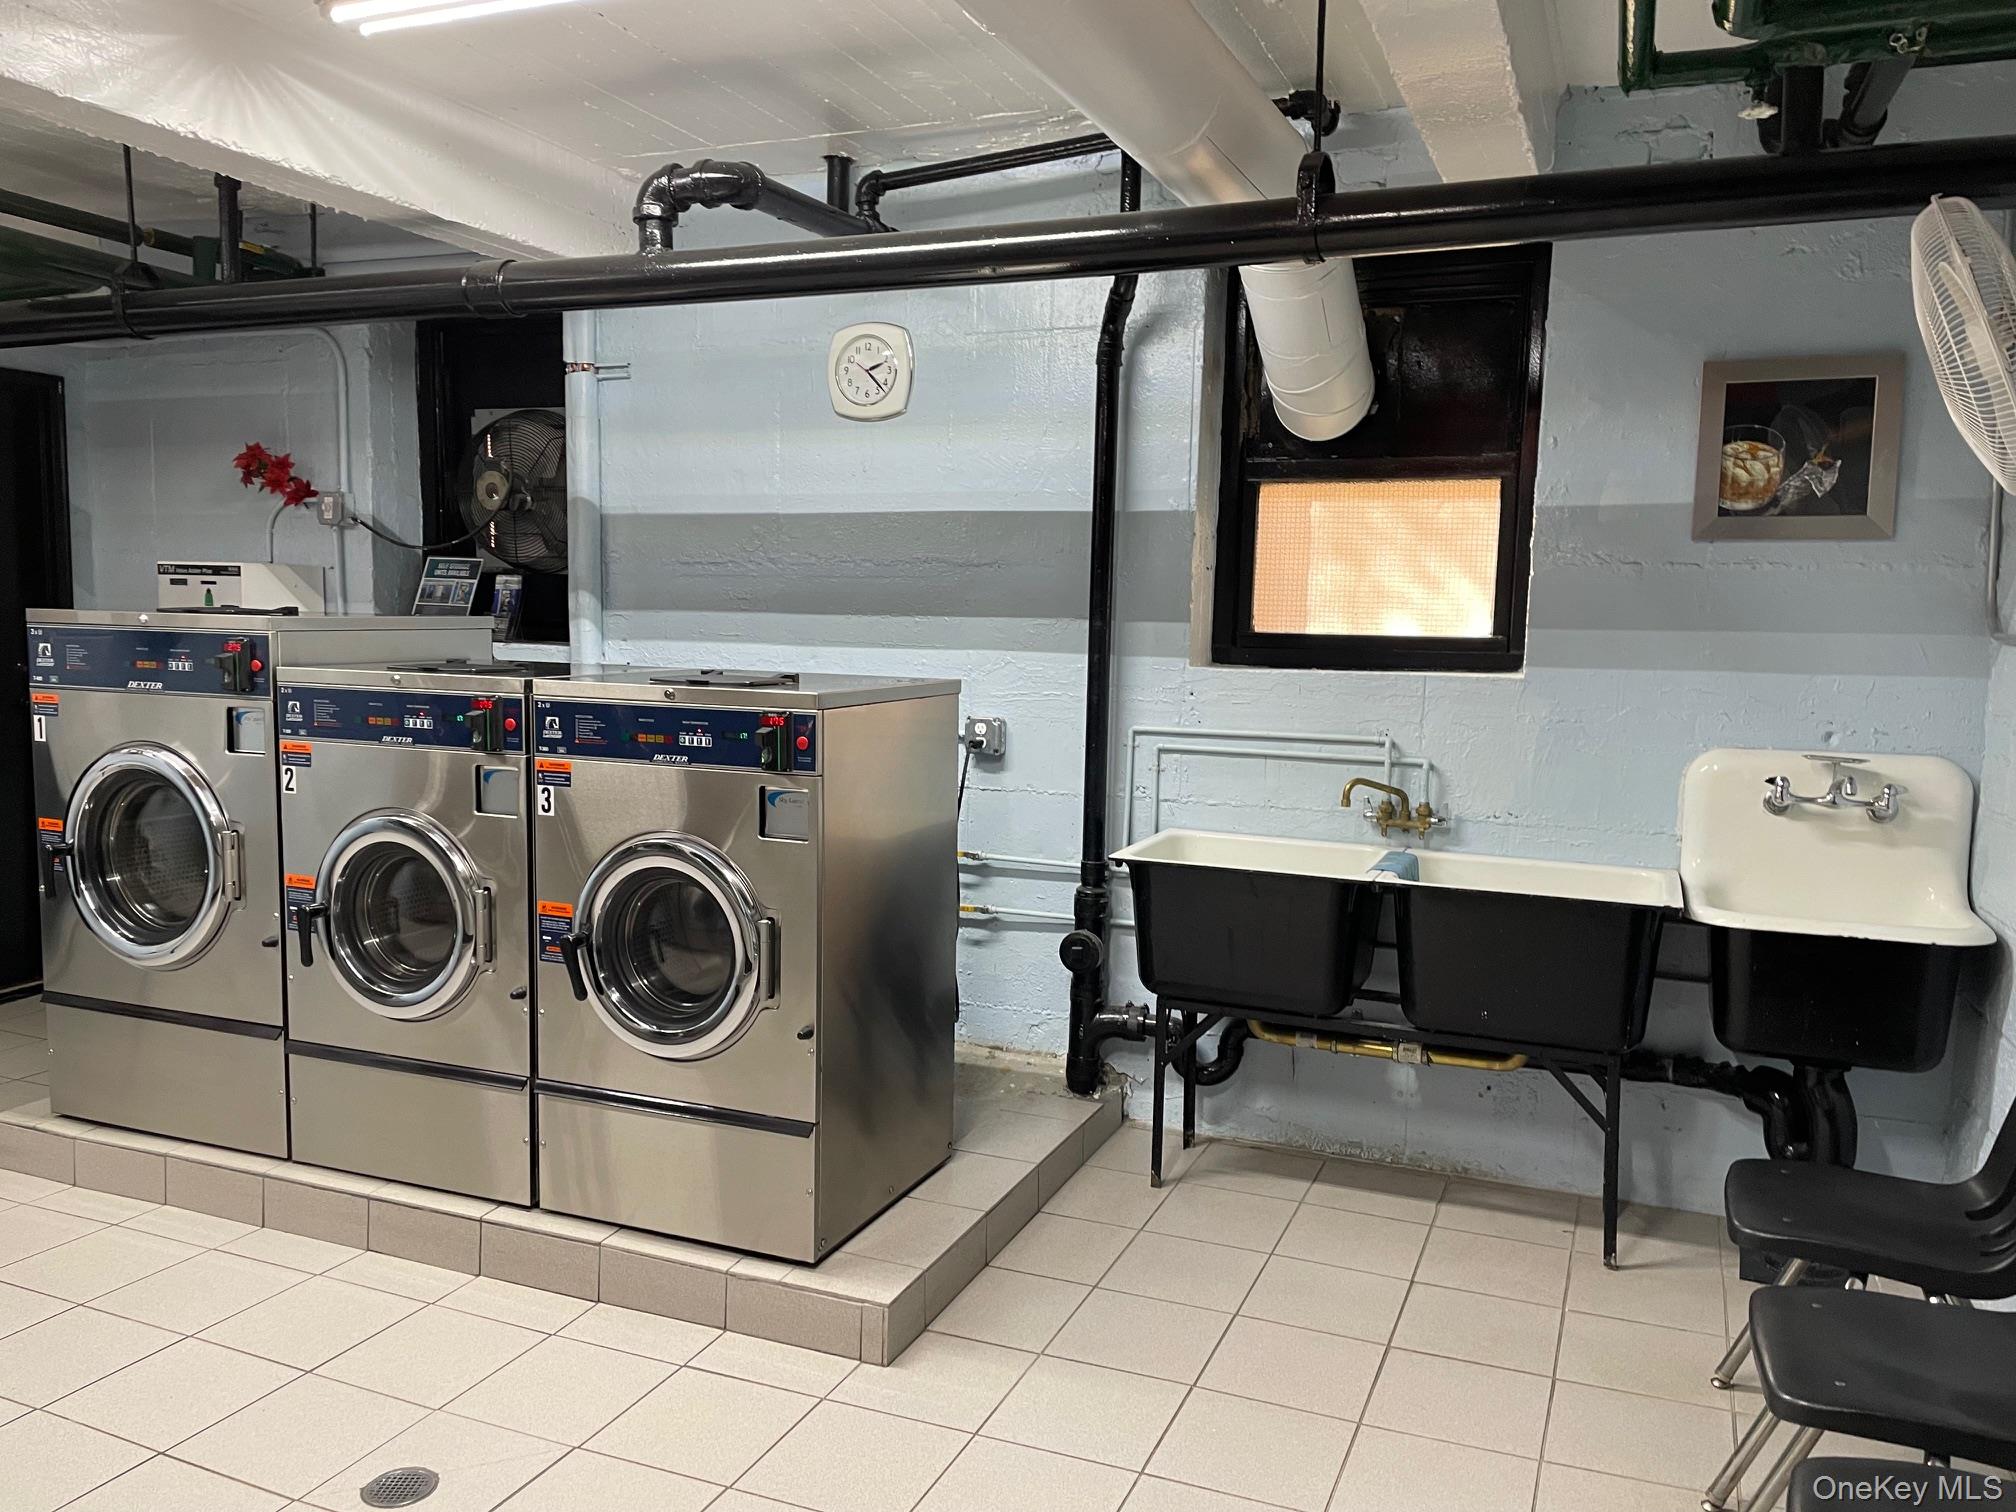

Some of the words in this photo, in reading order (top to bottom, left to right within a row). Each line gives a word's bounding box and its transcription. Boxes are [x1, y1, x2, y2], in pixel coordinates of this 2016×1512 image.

[855, 346, 861, 355] 11
[864, 342, 872, 351] 12
[876, 346, 880, 354] 1
[847, 355, 855, 364] 10
[843, 366, 849, 375] 9
[887, 365, 892, 374] 3
[847, 378, 853, 387] 8
[883, 378, 888, 386] 4
[855, 387, 860, 395] 7
[864, 390, 870, 398] 6
[875, 387, 880, 395] 5
[159, 565, 175, 573] VTM
[127, 681, 163, 689] DEXTER
[37, 717, 43, 740] 1
[652, 754, 689, 763] DEXTER
[284, 767, 295, 792] 2
[541, 787, 552, 814] 3
